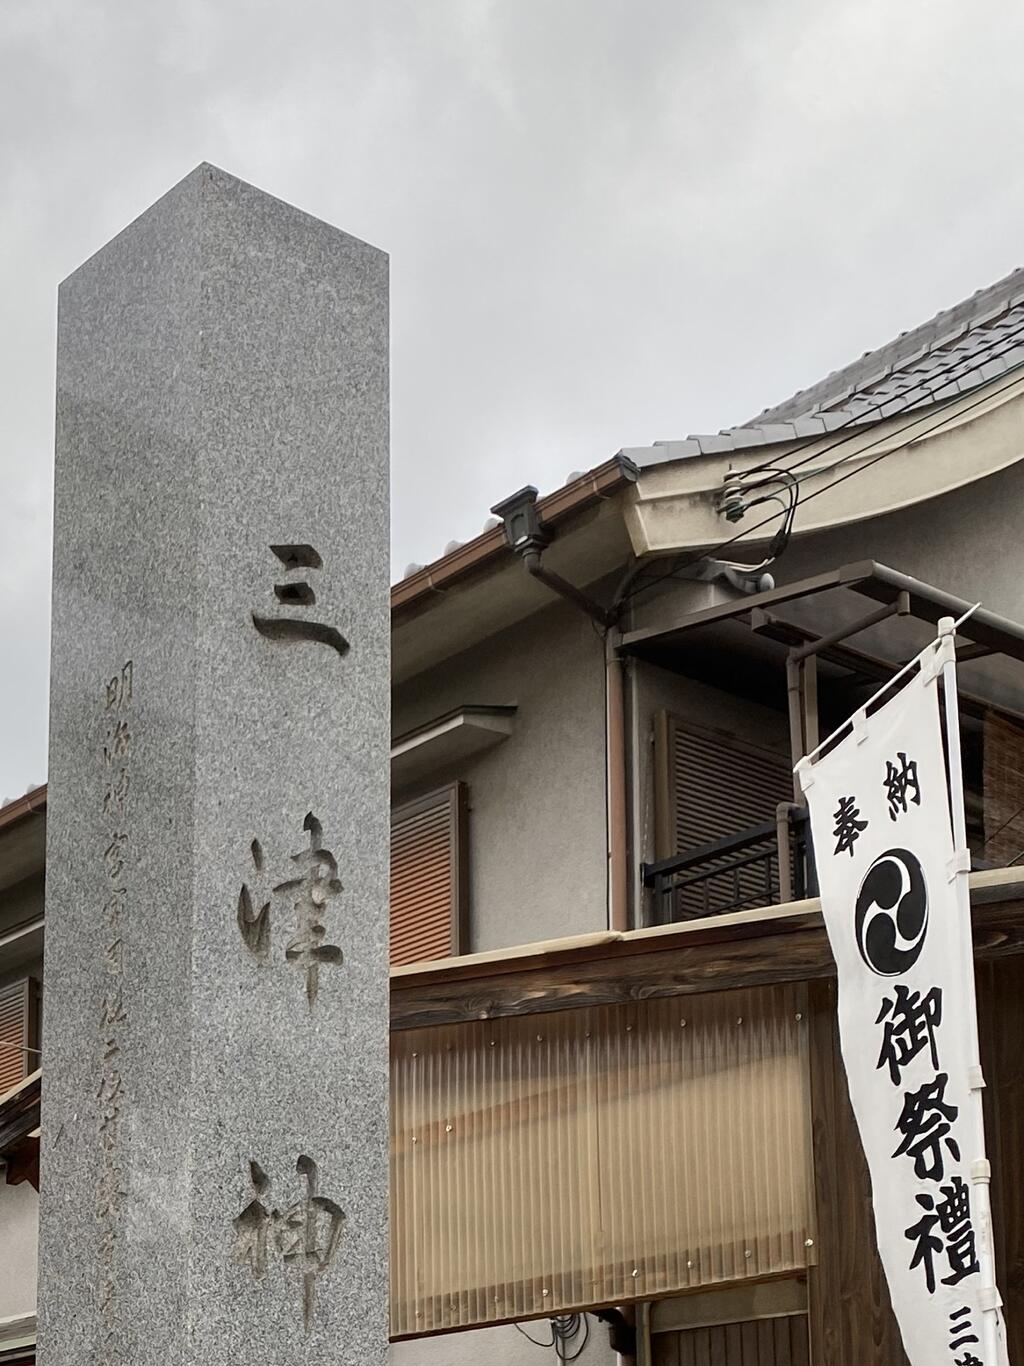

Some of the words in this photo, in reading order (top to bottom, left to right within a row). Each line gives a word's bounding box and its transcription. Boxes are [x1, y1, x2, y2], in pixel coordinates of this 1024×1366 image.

[833, 752, 920, 857] 奉納
[875, 985, 980, 1294] 御祭禮
